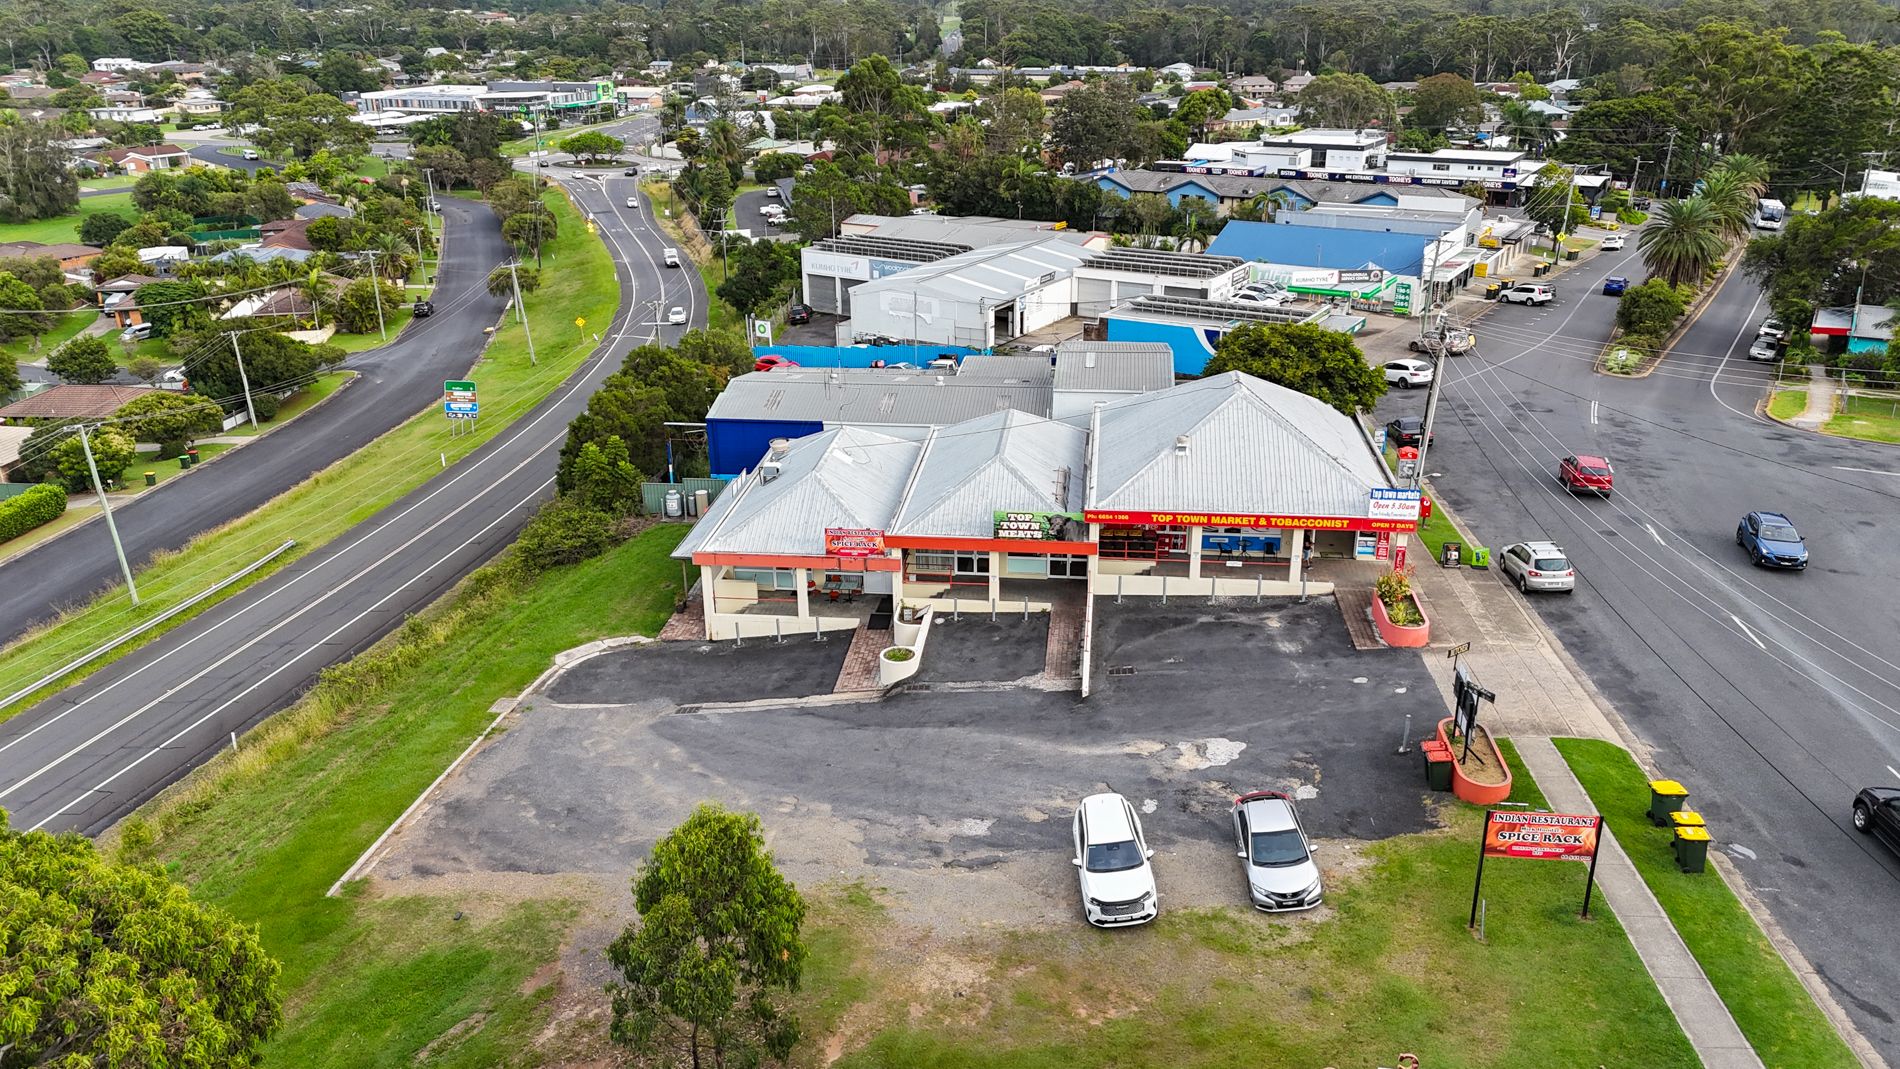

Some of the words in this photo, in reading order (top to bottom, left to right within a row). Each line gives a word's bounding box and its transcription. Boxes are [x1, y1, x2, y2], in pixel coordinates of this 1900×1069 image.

[1372, 490, 1382, 499] top
[1382, 490, 1397, 499] town
[1397, 491, 1420, 500] markets
[1373, 502, 1390, 510] Open
[1007, 513, 1033, 521] TOP
[1151, 514, 1174, 522] TOP
[1176, 515, 1207, 523] TOWN
[1211, 516, 1256, 525] MARKET
[1258, 517, 1267, 526] &
[1270, 517, 1350, 528] TOBACCONIST
[1000, 522, 1041, 530] TOWN
[998, 530, 1043, 538] MEATS
[1494, 814, 1529, 824] INDIAN
[1531, 815, 1595, 827] RESTAURANT
[1498, 832, 1540, 842] SPICE
[1542, 833, 1583, 844] RACK
